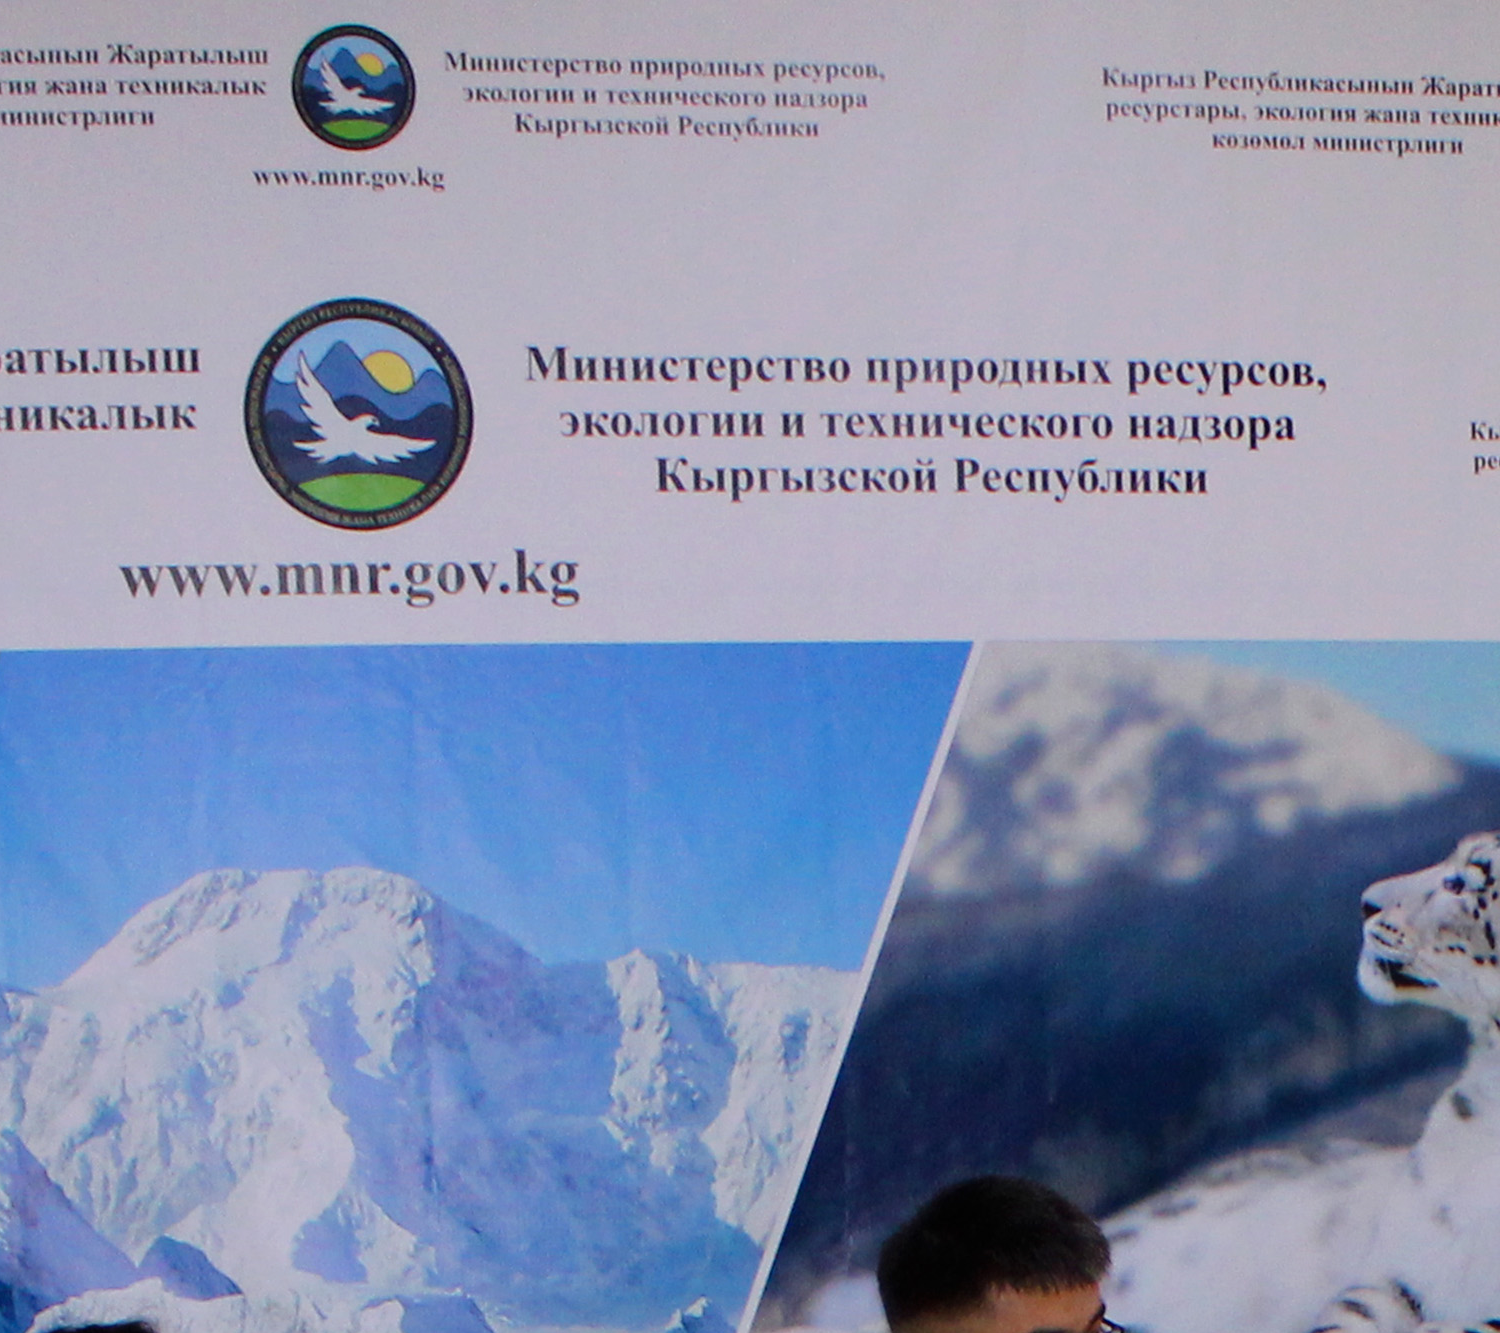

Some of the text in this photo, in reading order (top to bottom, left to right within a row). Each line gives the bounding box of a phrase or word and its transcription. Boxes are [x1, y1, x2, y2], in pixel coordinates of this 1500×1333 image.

[107, 44, 269, 71] Жаратылыш
[445, 51, 886, 84] Министерство природных ресурсов,
[45, 79, 108, 96] жана
[117, 79, 267, 96] техникалык
[1102, 67, 1196, 94] Кыргыз
[1204, 70, 1414, 97] Республикасынын
[463, 87, 868, 115] экологии и технического надзора
[1107, 102, 1247, 125] ресурстары,
[1256, 105, 1357, 123] экология
[1364, 108, 1421, 125] жана
[515, 112, 819, 142] Кыргызской Республики
[1313, 136, 1464, 159] министрлиги
[252, 166, 446, 193] www.mnr.gov.kg
[525, 345, 1328, 396] Министерство природных ресурсов,
[559, 411, 1296, 451] экологии и технического надзора
[655, 456, 1208, 504] Кыргызской Республики
[118, 548, 581, 609] www.mnr.gov.kg
